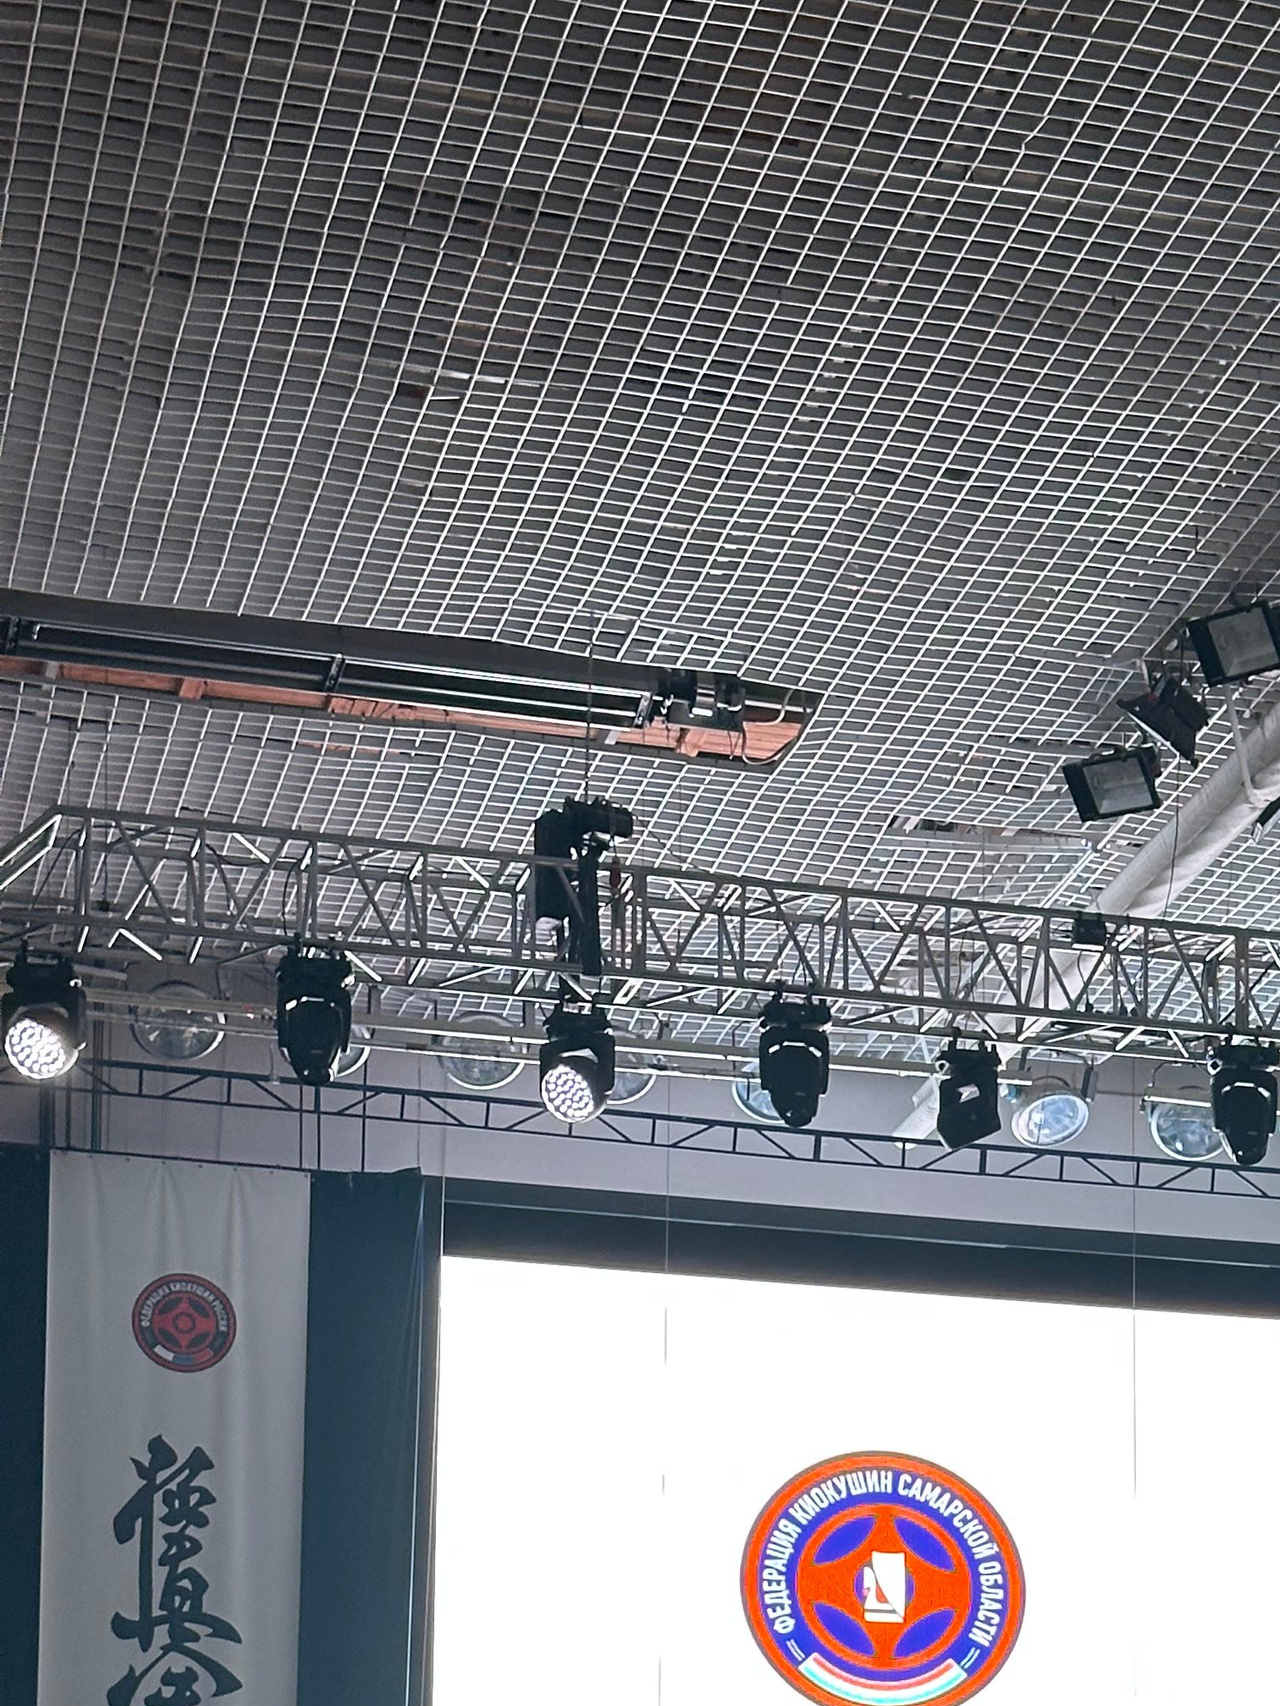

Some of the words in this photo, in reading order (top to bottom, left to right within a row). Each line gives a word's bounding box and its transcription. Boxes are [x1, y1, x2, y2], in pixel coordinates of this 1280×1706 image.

[762, 1519, 803, 1635] ФЕДЕРАЦИЯ
[788, 1469, 893, 1526] КИОКУШИН
[897, 1473, 1000, 1560] САМАРСКОЙ
[967, 1560, 1005, 1648] ОБЛАСТИ
